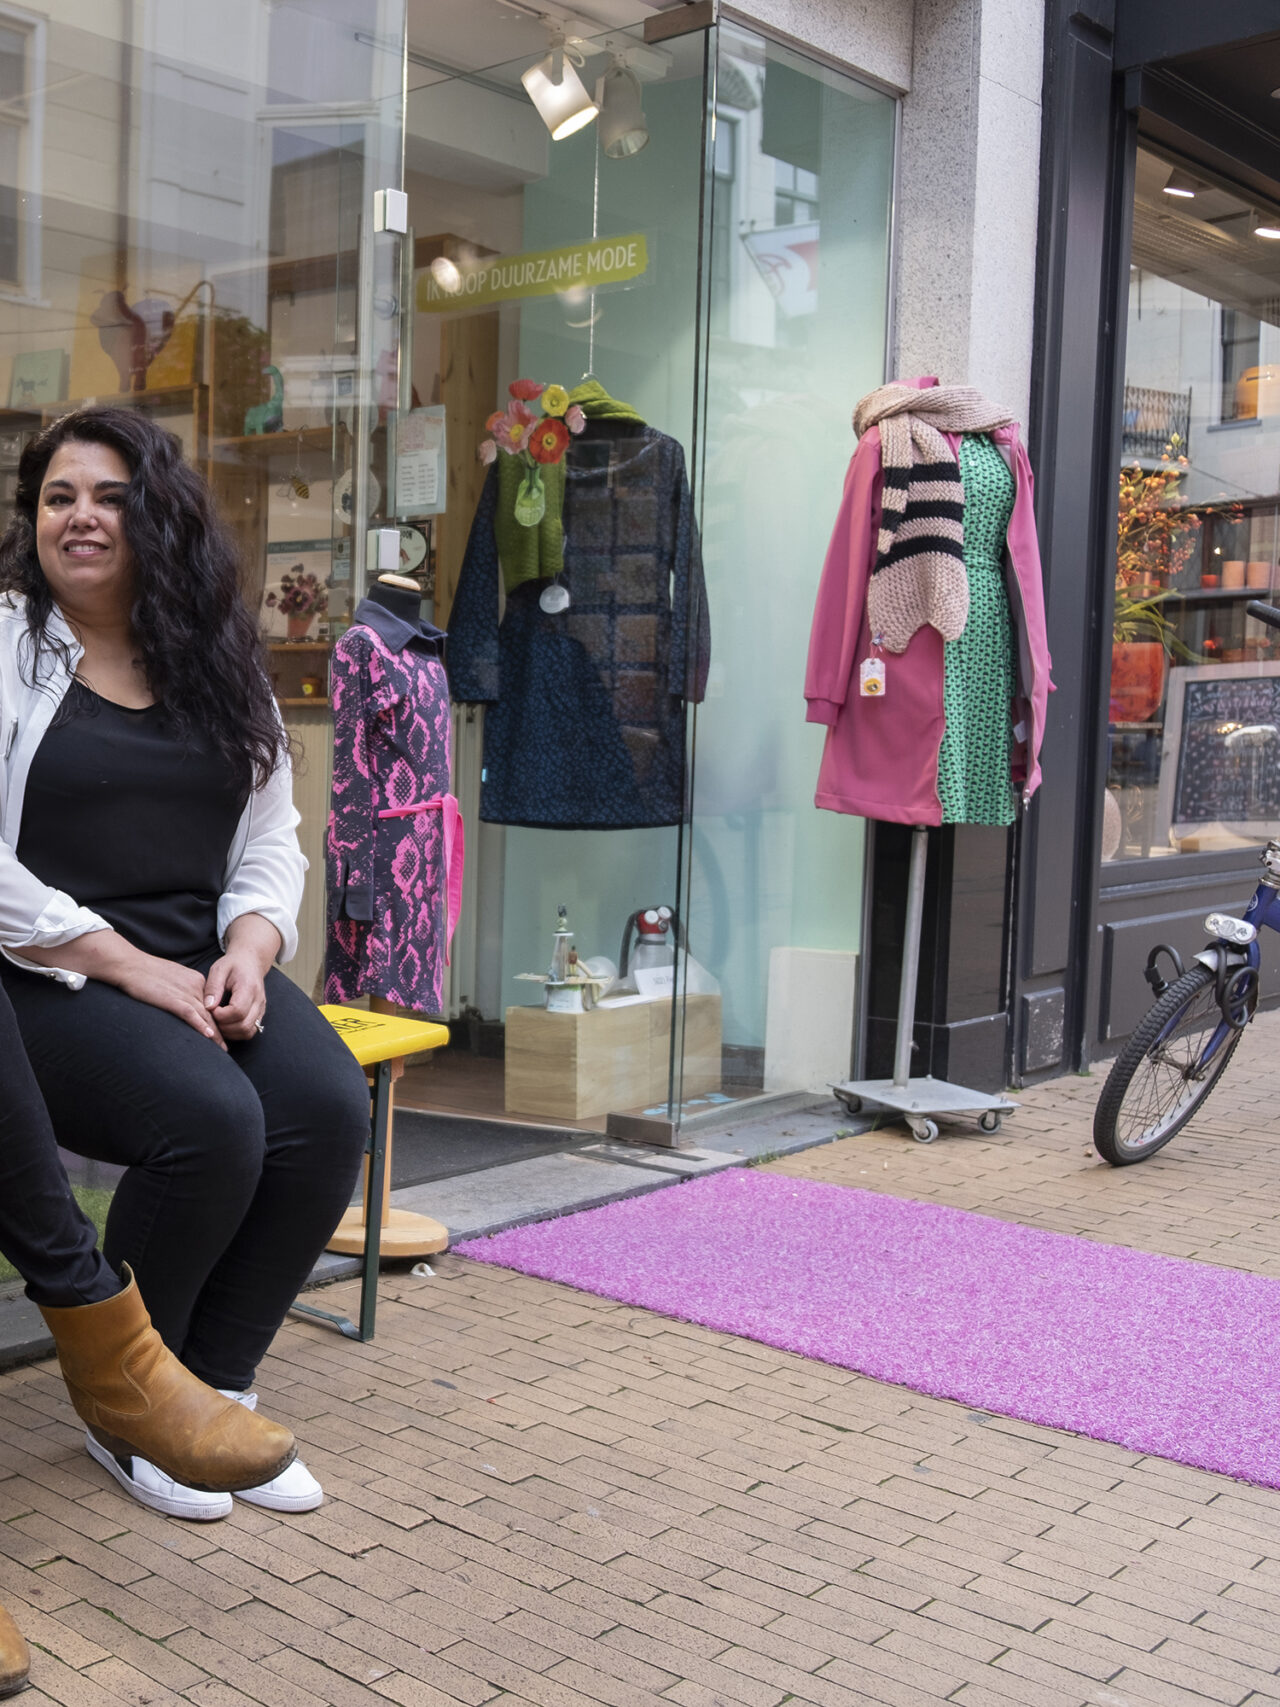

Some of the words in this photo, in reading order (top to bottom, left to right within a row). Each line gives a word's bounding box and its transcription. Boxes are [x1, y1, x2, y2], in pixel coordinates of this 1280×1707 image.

[426, 280, 440, 301] IK
[444, 271, 487, 298] OOP
[490, 252, 581, 289] DUURZAME
[587, 243, 637, 273] MODE
